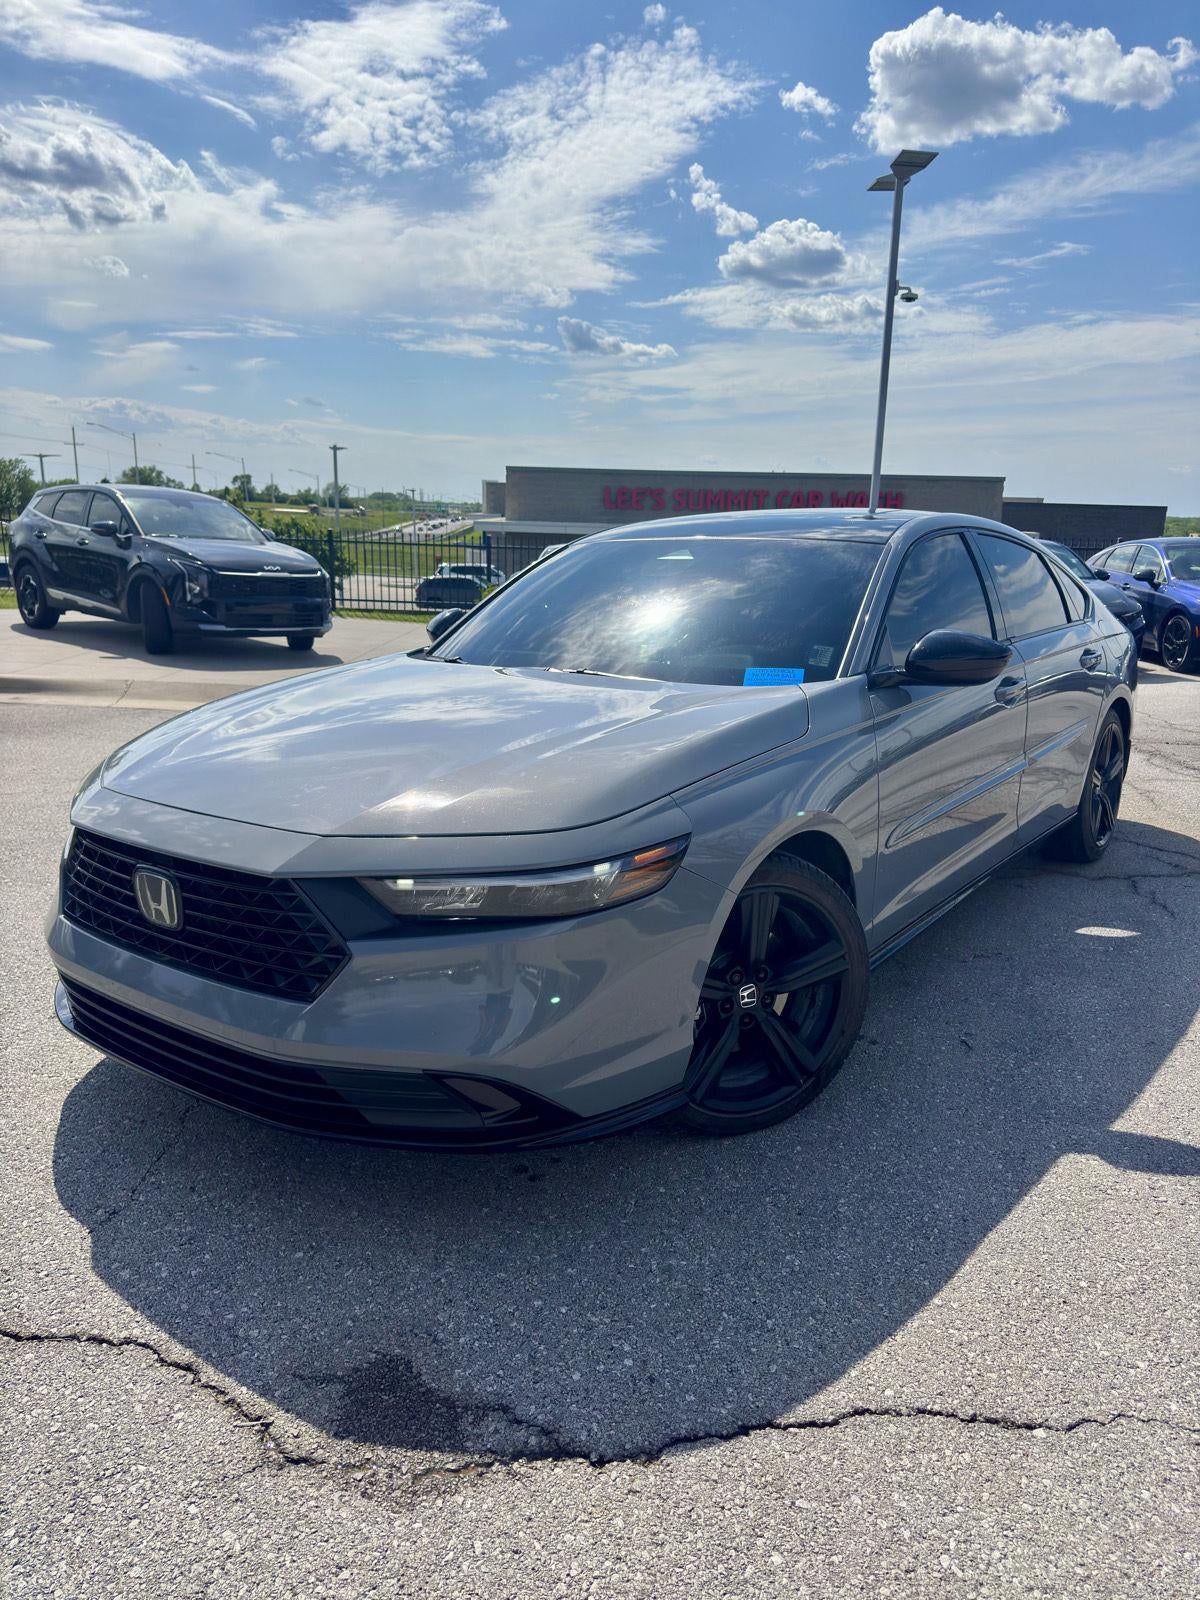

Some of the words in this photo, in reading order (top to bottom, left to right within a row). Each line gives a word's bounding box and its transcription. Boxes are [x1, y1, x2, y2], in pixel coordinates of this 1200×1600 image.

[603, 486, 666, 511] LEE'S
[672, 488, 769, 512] SUMMIT
[776, 489, 824, 509] CAR
